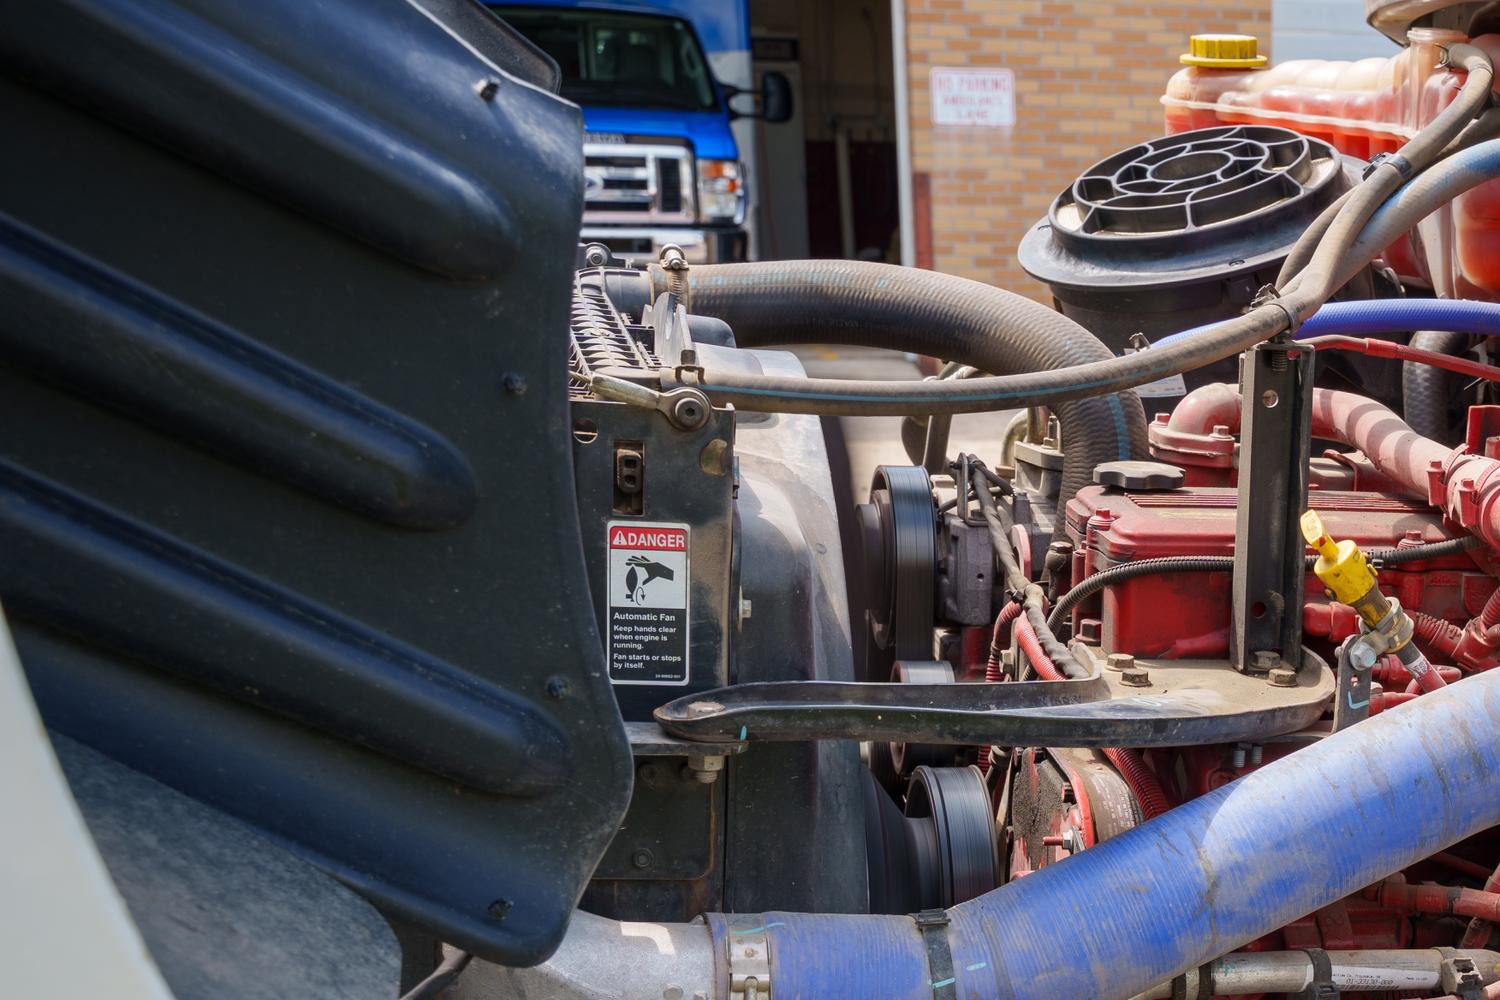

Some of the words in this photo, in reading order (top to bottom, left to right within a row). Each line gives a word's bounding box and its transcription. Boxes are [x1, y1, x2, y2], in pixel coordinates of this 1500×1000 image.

[628, 533, 685, 548] DANGER
[613, 612, 658, 621] Automatic
[659, 613, 676, 621] Fan
[613, 625, 633, 634] Keep
[634, 634, 660, 643] engine
[613, 642, 644, 650] running.
[661, 655, 682, 663] stops
